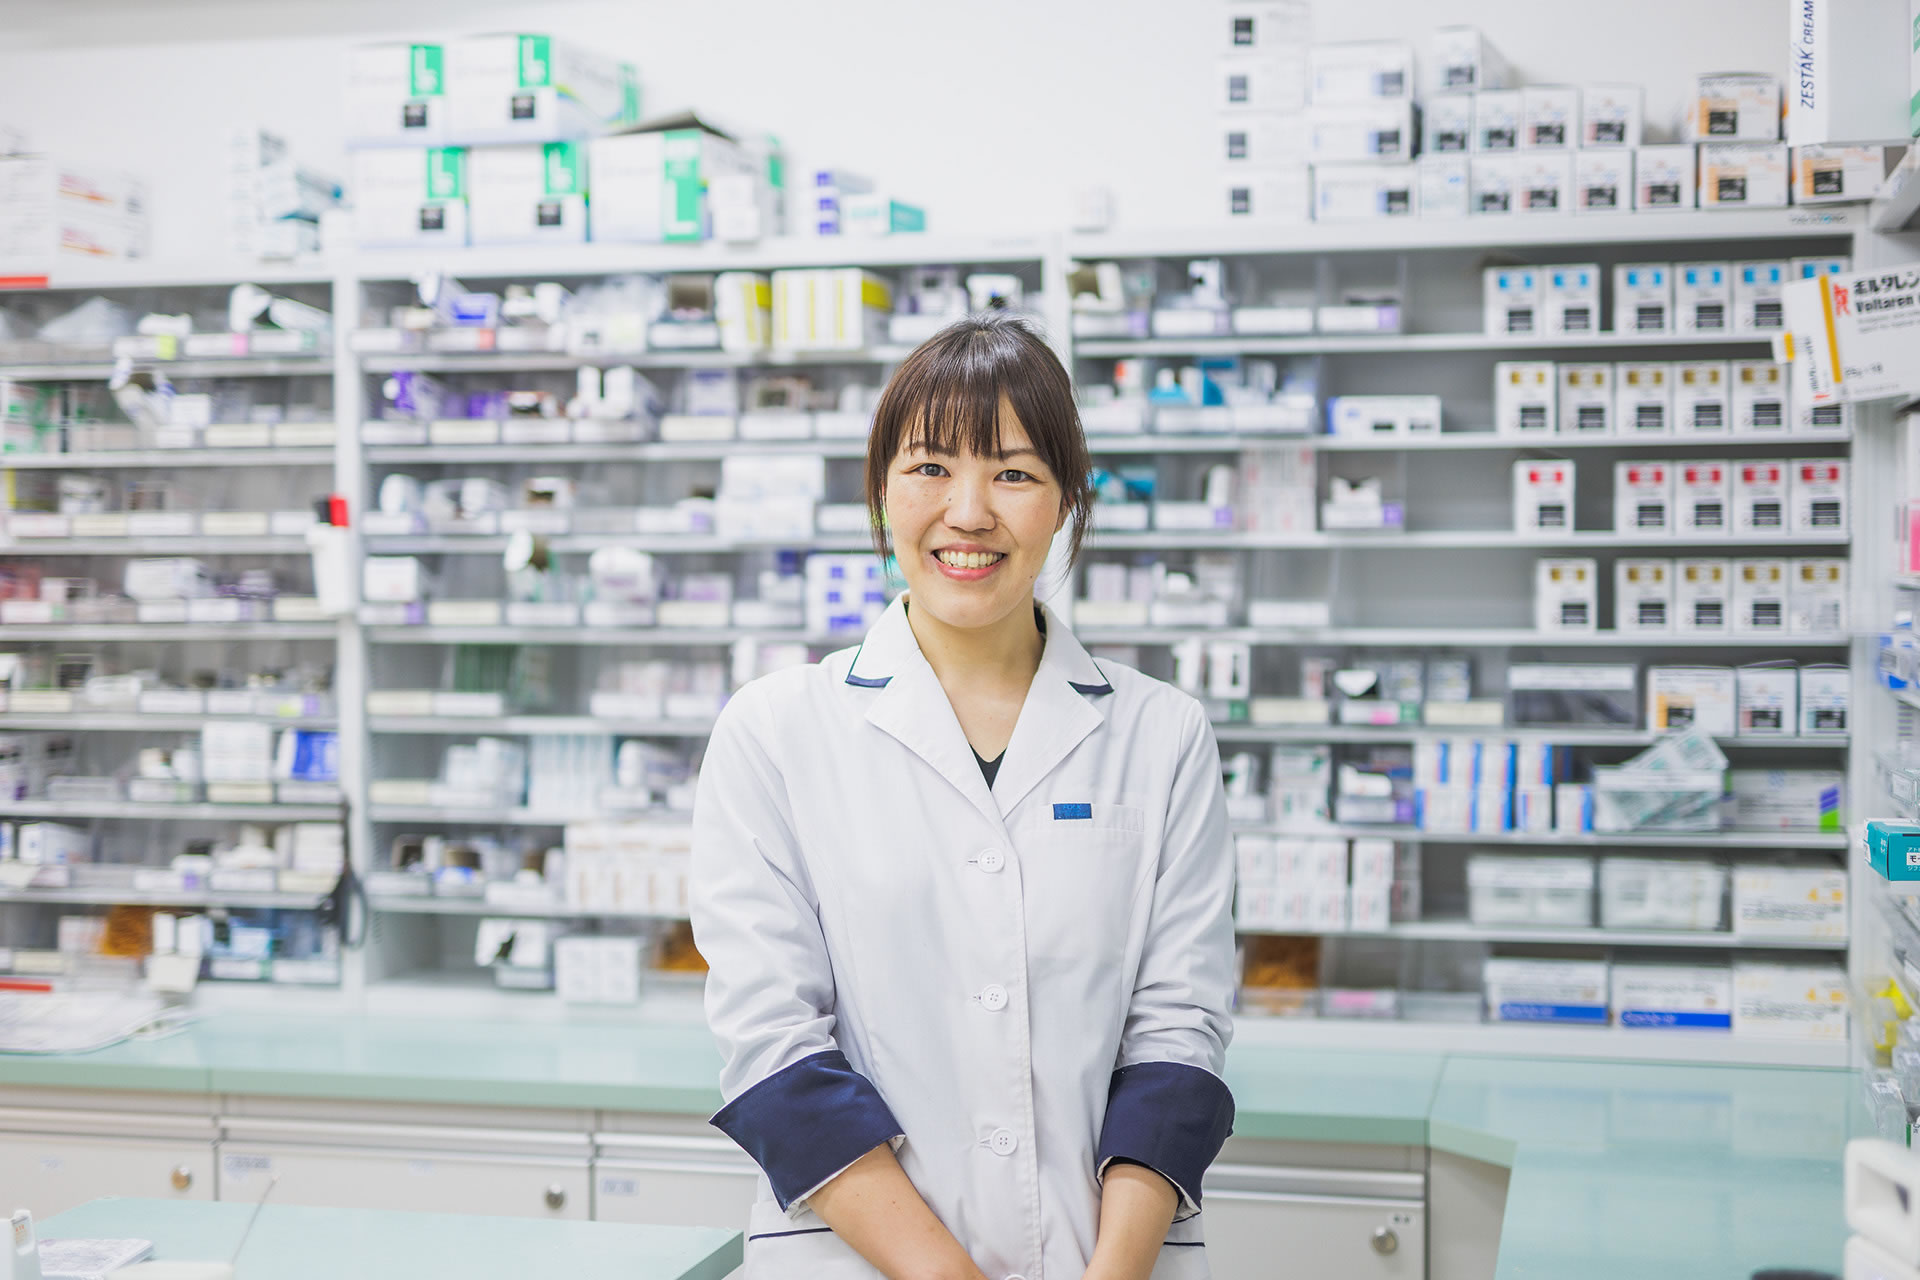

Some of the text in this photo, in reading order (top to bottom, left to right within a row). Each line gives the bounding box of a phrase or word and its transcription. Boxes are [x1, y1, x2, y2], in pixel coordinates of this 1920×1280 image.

[1800, 0, 1815, 109] ZESTAK CREAM
[1856, 296, 1914, 313] Voltaren
